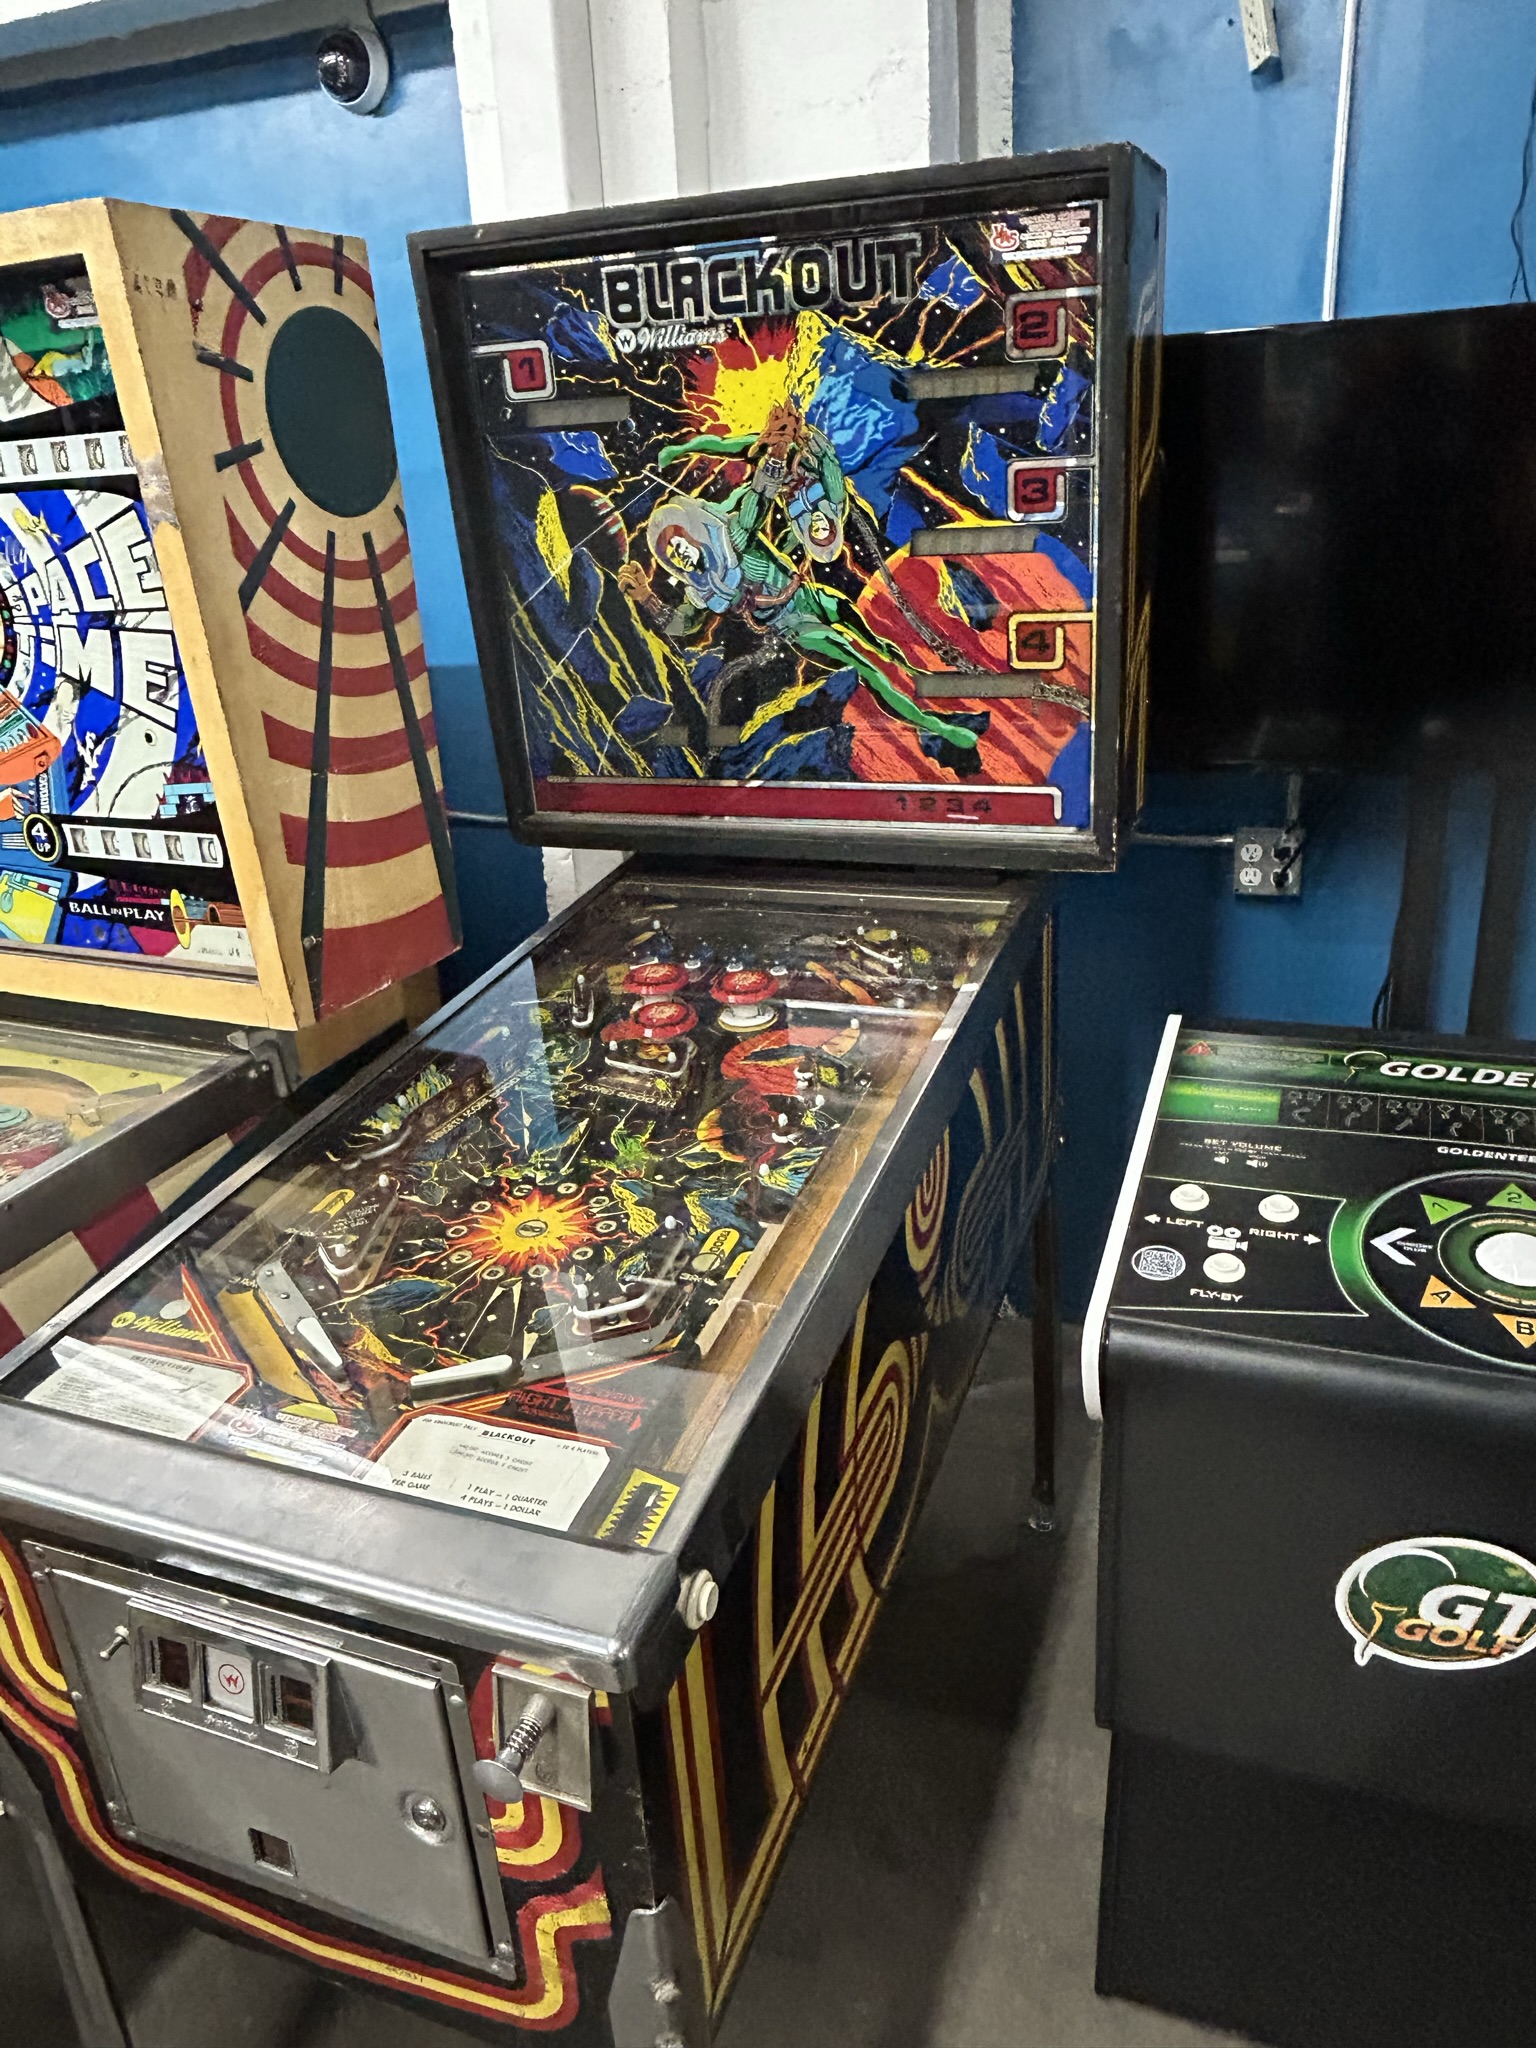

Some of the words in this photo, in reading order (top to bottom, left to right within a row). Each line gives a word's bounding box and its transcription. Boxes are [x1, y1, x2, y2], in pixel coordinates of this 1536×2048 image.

[601, 232, 922, 329] BLACKOUT
[1020, 311, 1050, 339] 2
[637, 325, 727, 353] Williams
[519, 357, 536, 381] 1
[1021, 477, 1049, 505] 3
[6, 504, 167, 615] SPACE
[1022, 629, 1050, 654] 4
[13, 622, 178, 731] TIME
[896, 795, 907, 811] 1
[972, 799, 992, 812] 4
[31, 823, 48, 840] 4
[36, 842, 51, 852] UP
[69, 901, 111, 916] BALL
[111, 907, 122, 916] IN
[123, 907, 165, 922] PLAY
[1379, 1061, 1536, 1088] GOLDE
[1204, 1138, 1228, 1147] SET
[1231, 1141, 1282, 1152] VOLUME
[1431, 1202, 1449, 1212] 1
[1507, 1191, 1522, 1204] 2
[1166, 1216, 1204, 1228] LEFT
[1249, 1228, 1300, 1241] RIGHT
[1189, 1287, 1243, 1303] FLY-BY
[1430, 1290, 1452, 1304] A
[1516, 1321, 1535, 1336] B
[479, 1430, 538, 1446] BLACKOUT
[391, 1478, 406, 1487] PER
[468, 1496, 493, 1508] PLAYS
[509, 1505, 543, 1517] DOLLAR
[473, 1486, 495, 1497] PLAY
[511, 1494, 548, 1507] QUARTER
[1418, 1584, 1536, 1638] GT
[1394, 1617, 1522, 1655] GOLF
